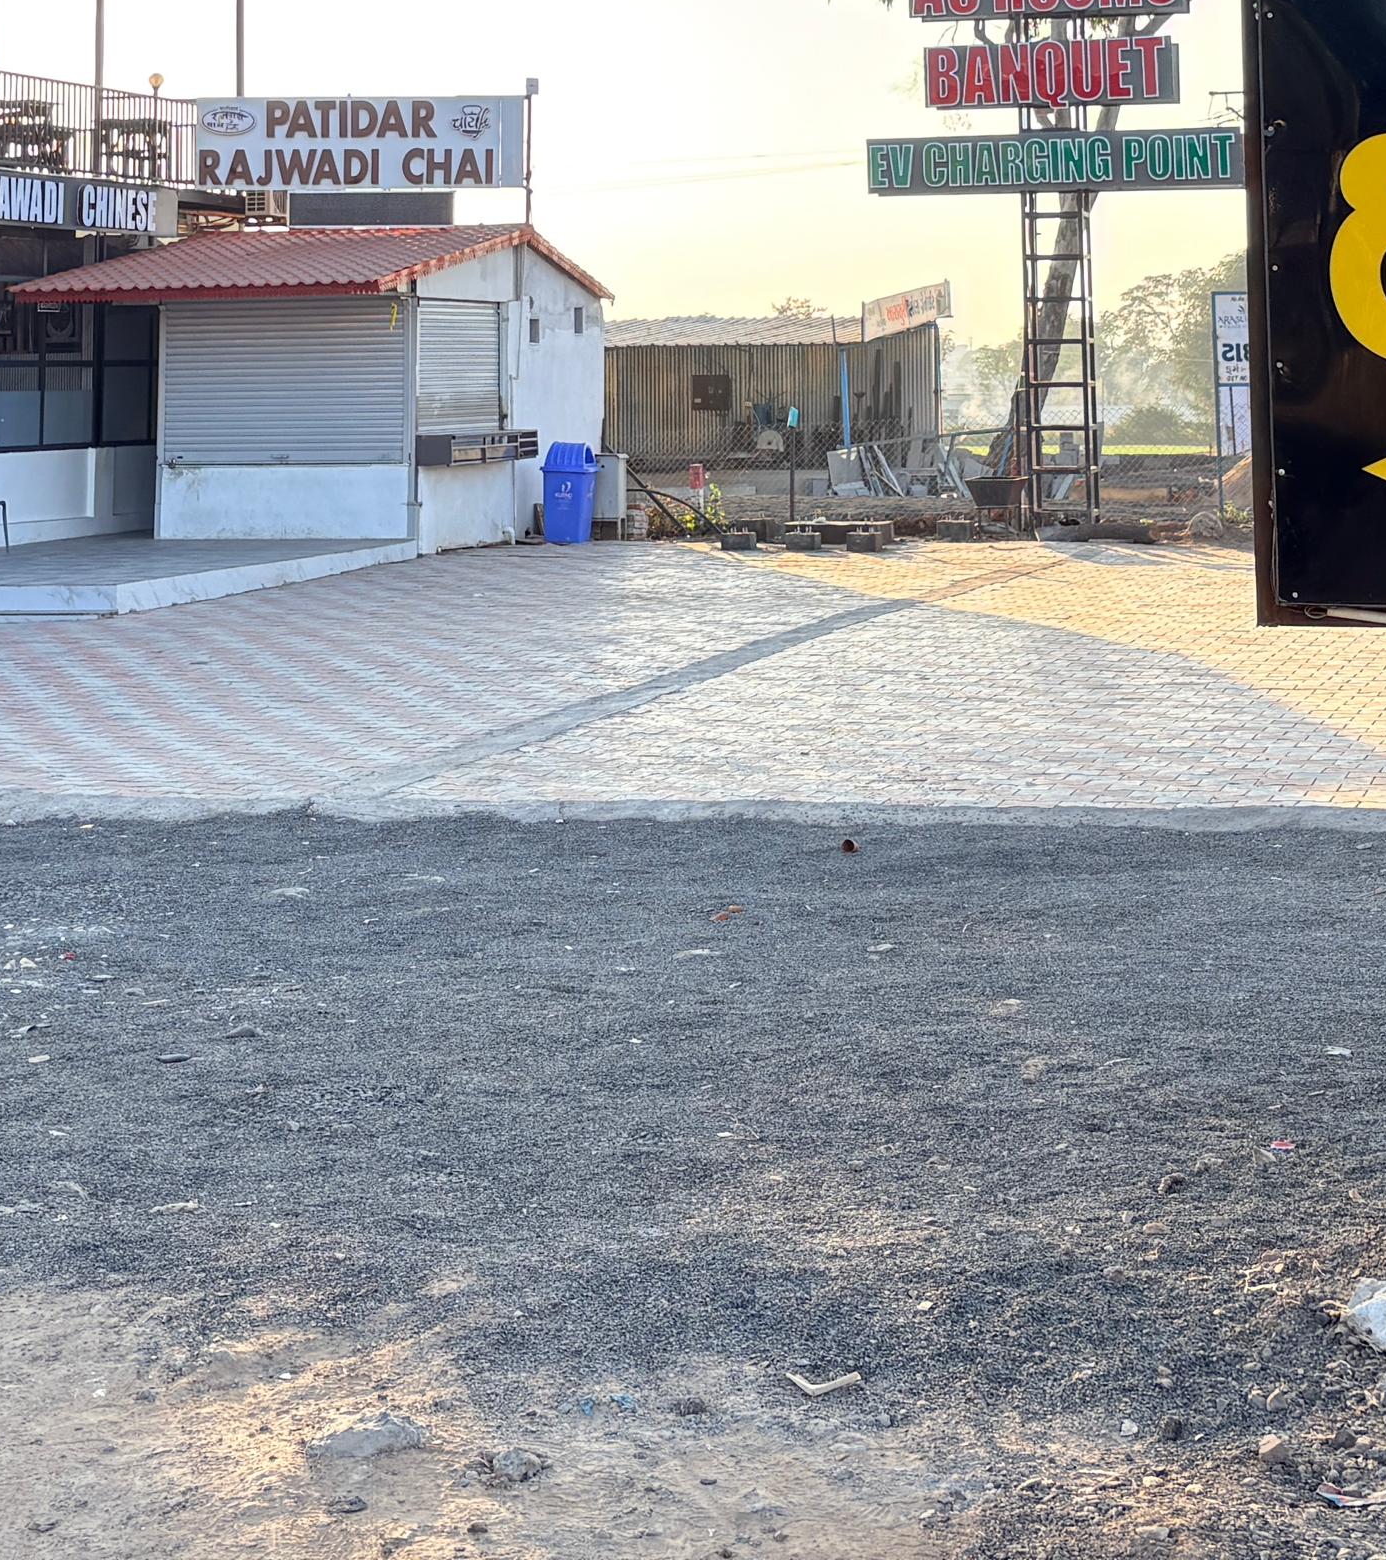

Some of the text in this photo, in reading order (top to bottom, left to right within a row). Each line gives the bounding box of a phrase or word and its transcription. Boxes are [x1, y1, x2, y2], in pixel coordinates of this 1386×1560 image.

[926, 36, 1164, 109] BANQUET
[266, 100, 437, 138] PATIDAR
[198, 147, 493, 187] RAJWADI CHAI
[868, 133, 1235, 188] EV CHARGING POINT
[81, 184, 156, 232] CHINESE
